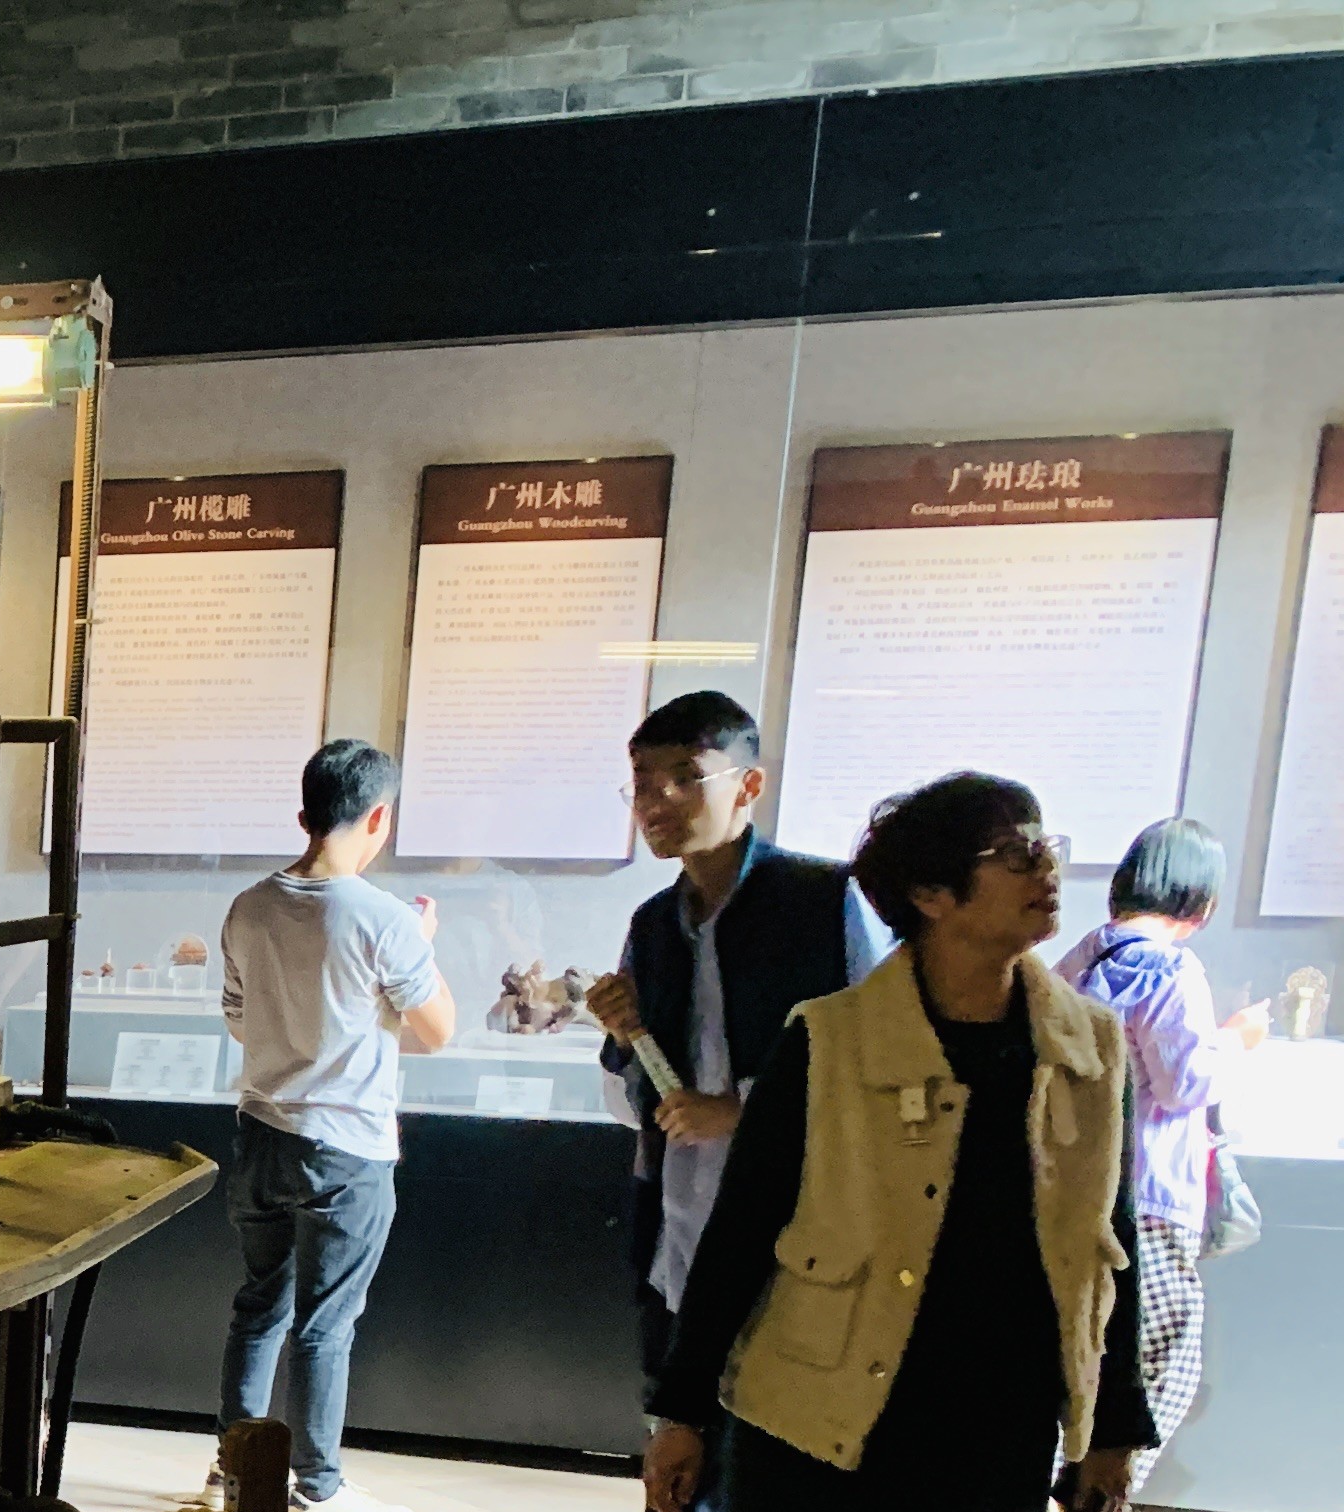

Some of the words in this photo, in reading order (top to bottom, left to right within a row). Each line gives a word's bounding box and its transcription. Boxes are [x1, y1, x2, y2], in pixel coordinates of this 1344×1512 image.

[948, 458, 1082, 493] 广州珐琅
[485, 479, 603, 511] 广州木雕
[910, 501, 997, 517] Guangzhou
[1002, 498, 1059, 512] Enamel
[1064, 496, 1114, 509] Works
[145, 493, 253, 524] 广州榄雕
[100, 531, 169, 546] Guangzhou
[172, 529, 205, 542] Olive
[207, 528, 243, 541] Stone
[246, 526, 296, 541] Carving
[457, 517, 534, 533] Guangzhou
[538, 514, 629, 529] Woodcarving
